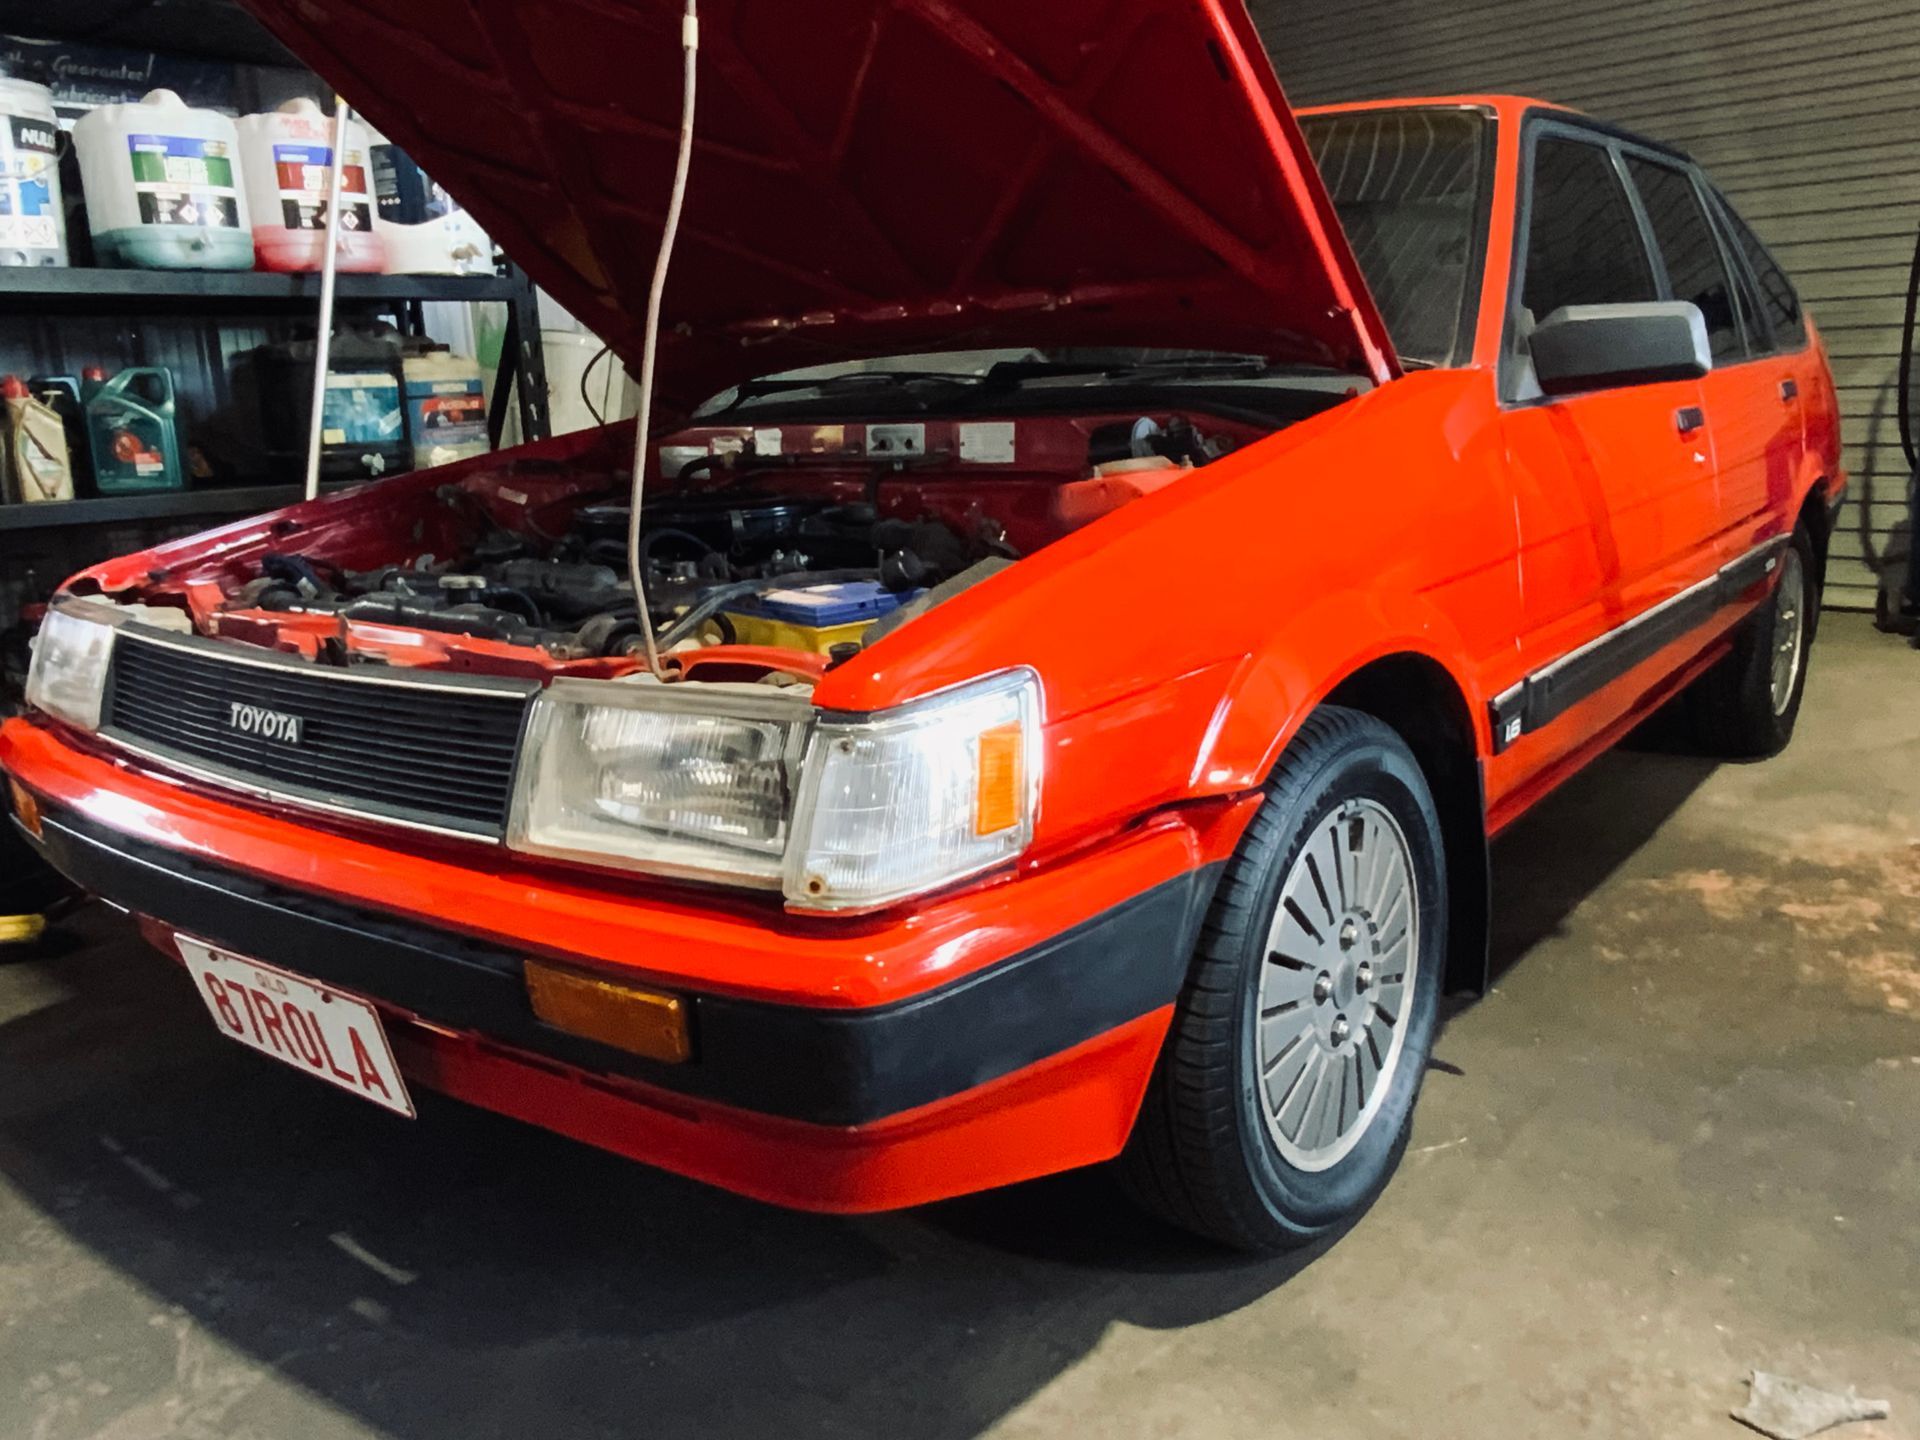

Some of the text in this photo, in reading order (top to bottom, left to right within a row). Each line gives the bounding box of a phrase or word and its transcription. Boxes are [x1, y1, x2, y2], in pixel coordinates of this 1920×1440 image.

[230, 701, 297, 742] TOYOTA
[254, 971, 288, 995] QLD
[204, 971, 392, 1100] 87ROLA
